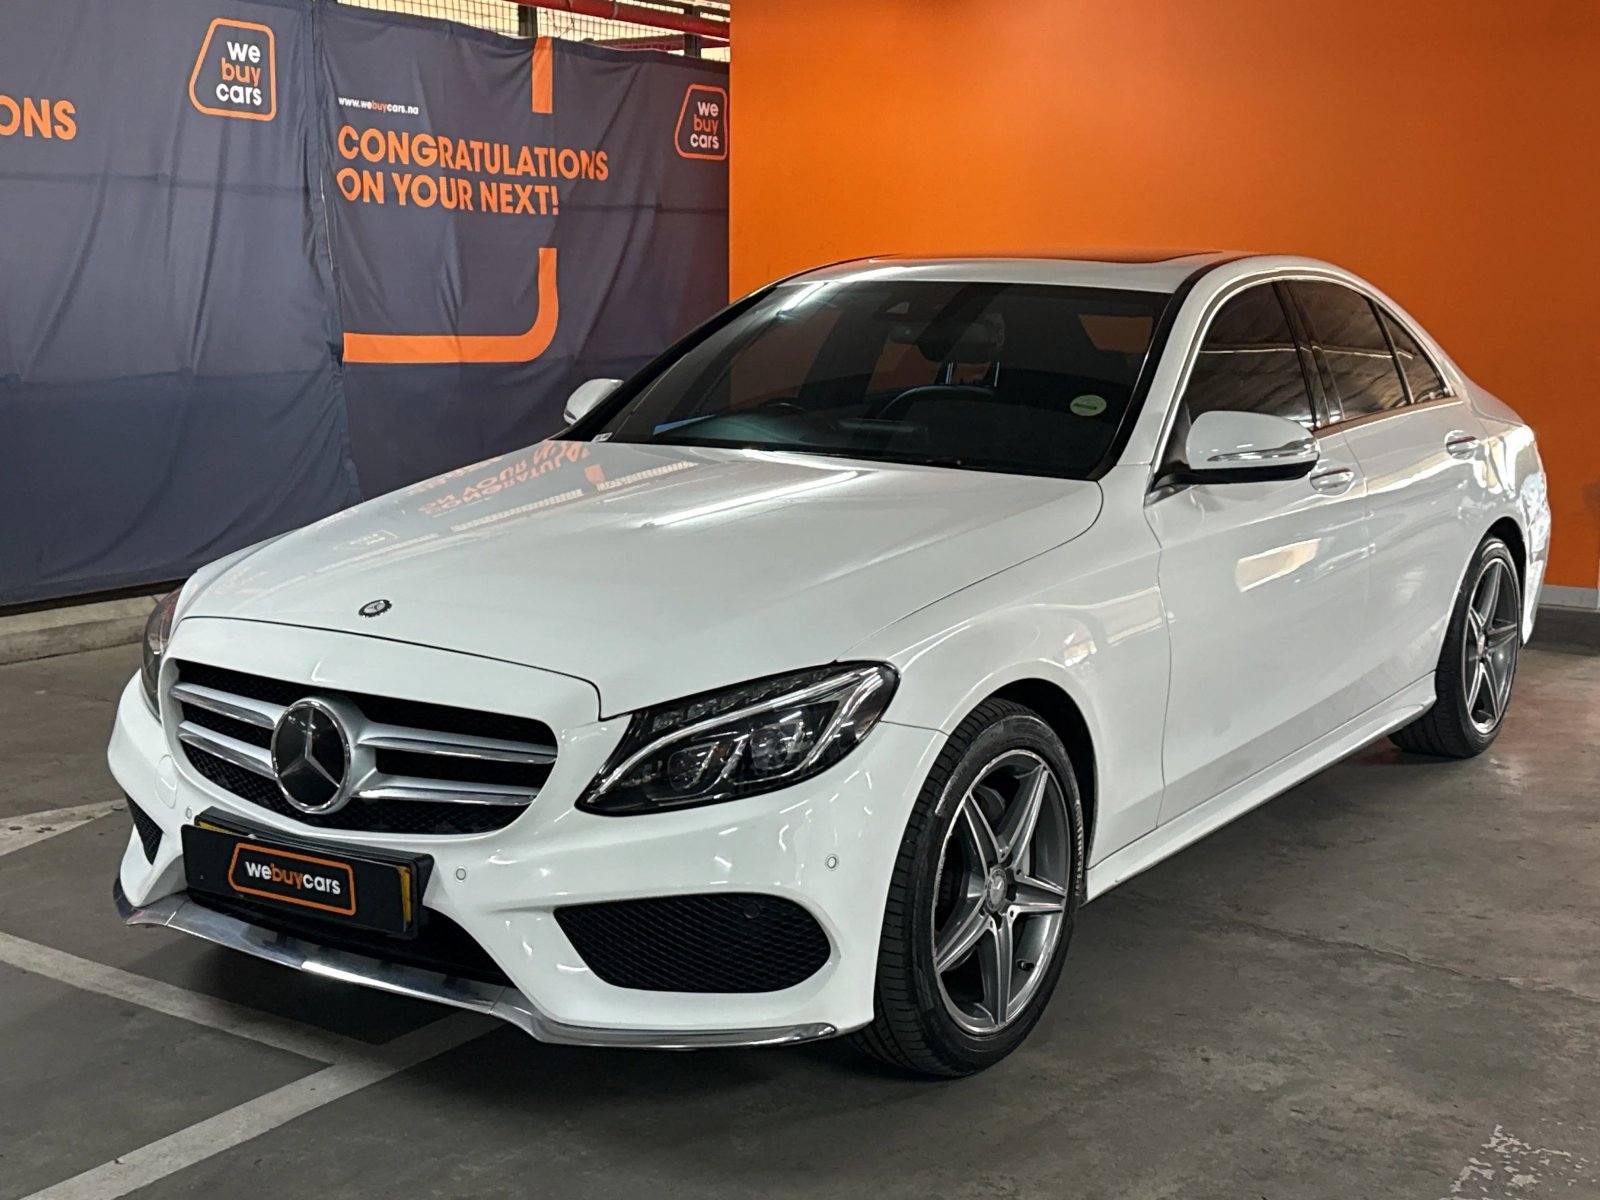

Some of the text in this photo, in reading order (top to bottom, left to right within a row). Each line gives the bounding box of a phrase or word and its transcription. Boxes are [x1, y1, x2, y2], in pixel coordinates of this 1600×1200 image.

[226, 41, 261, 63] we
[221, 58, 261, 87] buy
[216, 82, 263, 107] cars
[338, 97, 419, 115] www.webuycars.na
[697, 100, 719, 118] we
[693, 114, 719, 136] buy
[689, 133, 720, 150] cars
[337, 125, 609, 182] CONGRATULATIONS
[336, 167, 559, 215] ON YOUR NEXT!
[245, 861, 341, 895] webuycars
